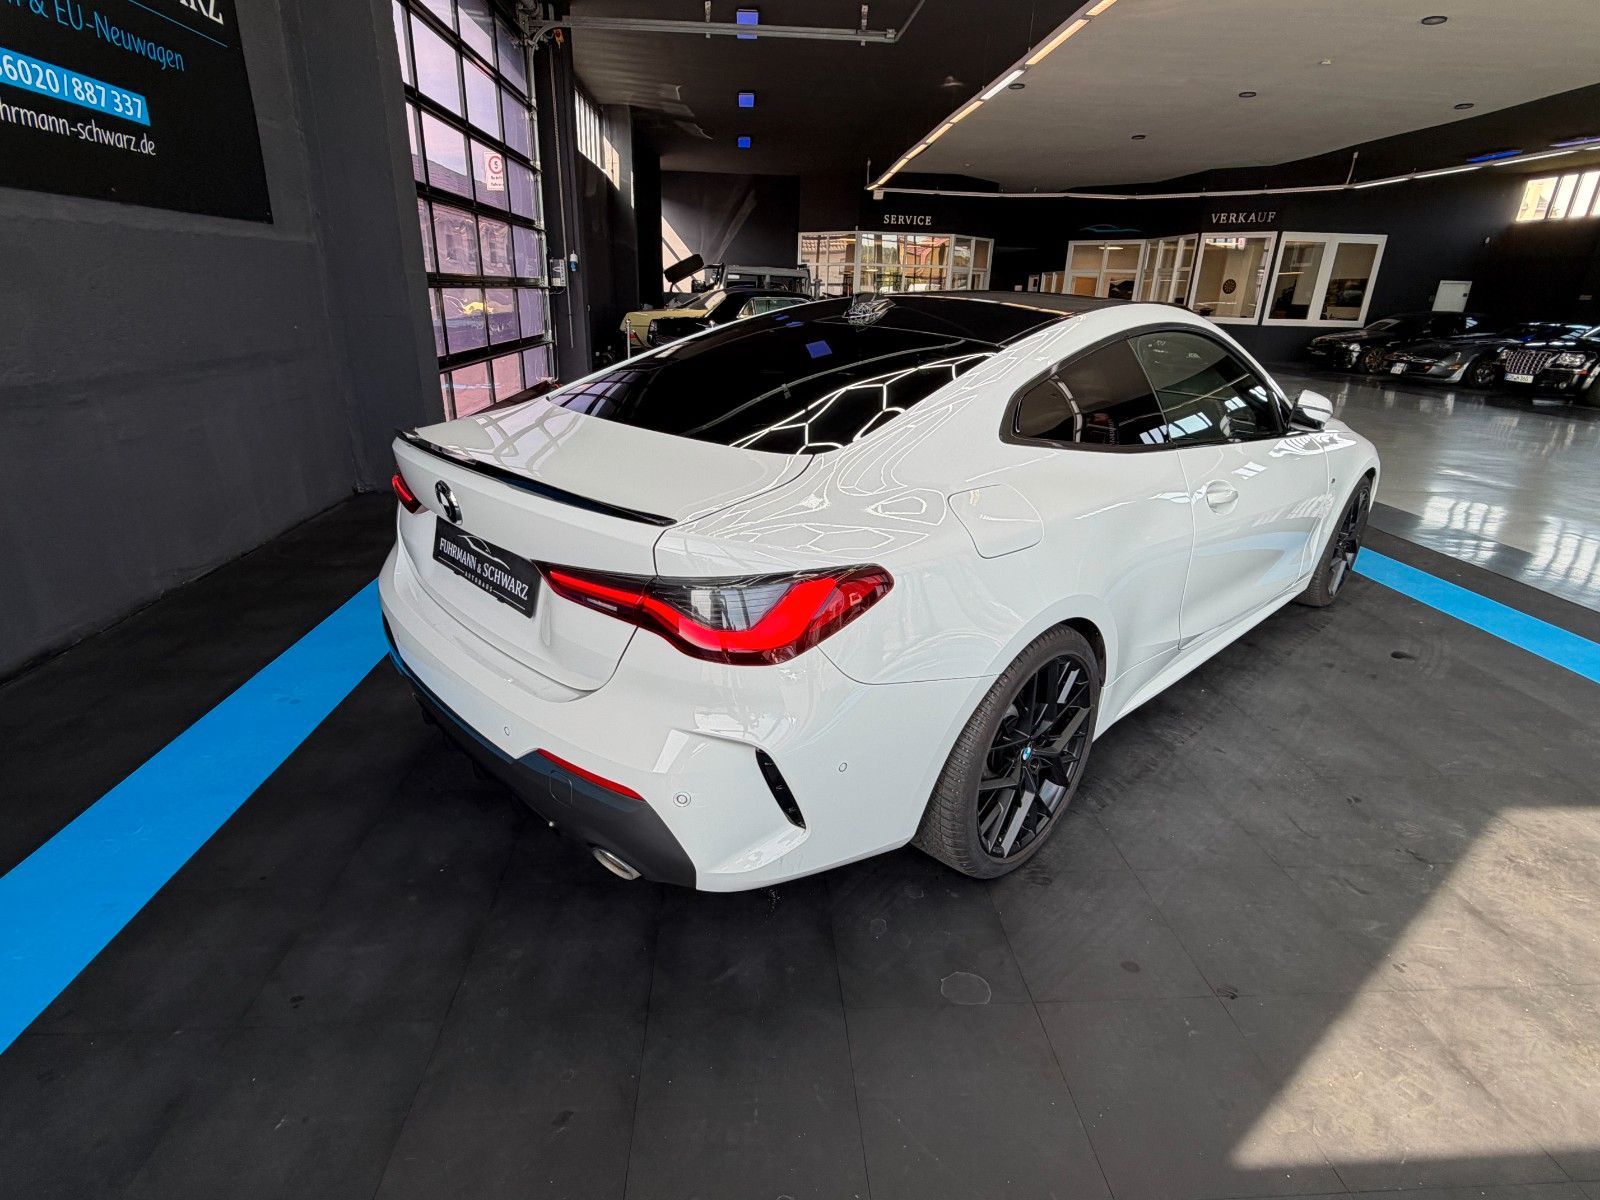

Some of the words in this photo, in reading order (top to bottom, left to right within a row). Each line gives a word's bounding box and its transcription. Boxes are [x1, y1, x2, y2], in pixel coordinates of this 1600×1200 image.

[54, 0, 185, 71] EU-Neuwagen
[110, 89, 142, 118] 337
[883, 214, 932, 226] SERVICE
[1211, 211, 1277, 224] VERKAUF
[439, 537, 477, 570] FUHRMANN
[476, 563, 482, 574] &
[482, 563, 529, 600] SCHWARZ
